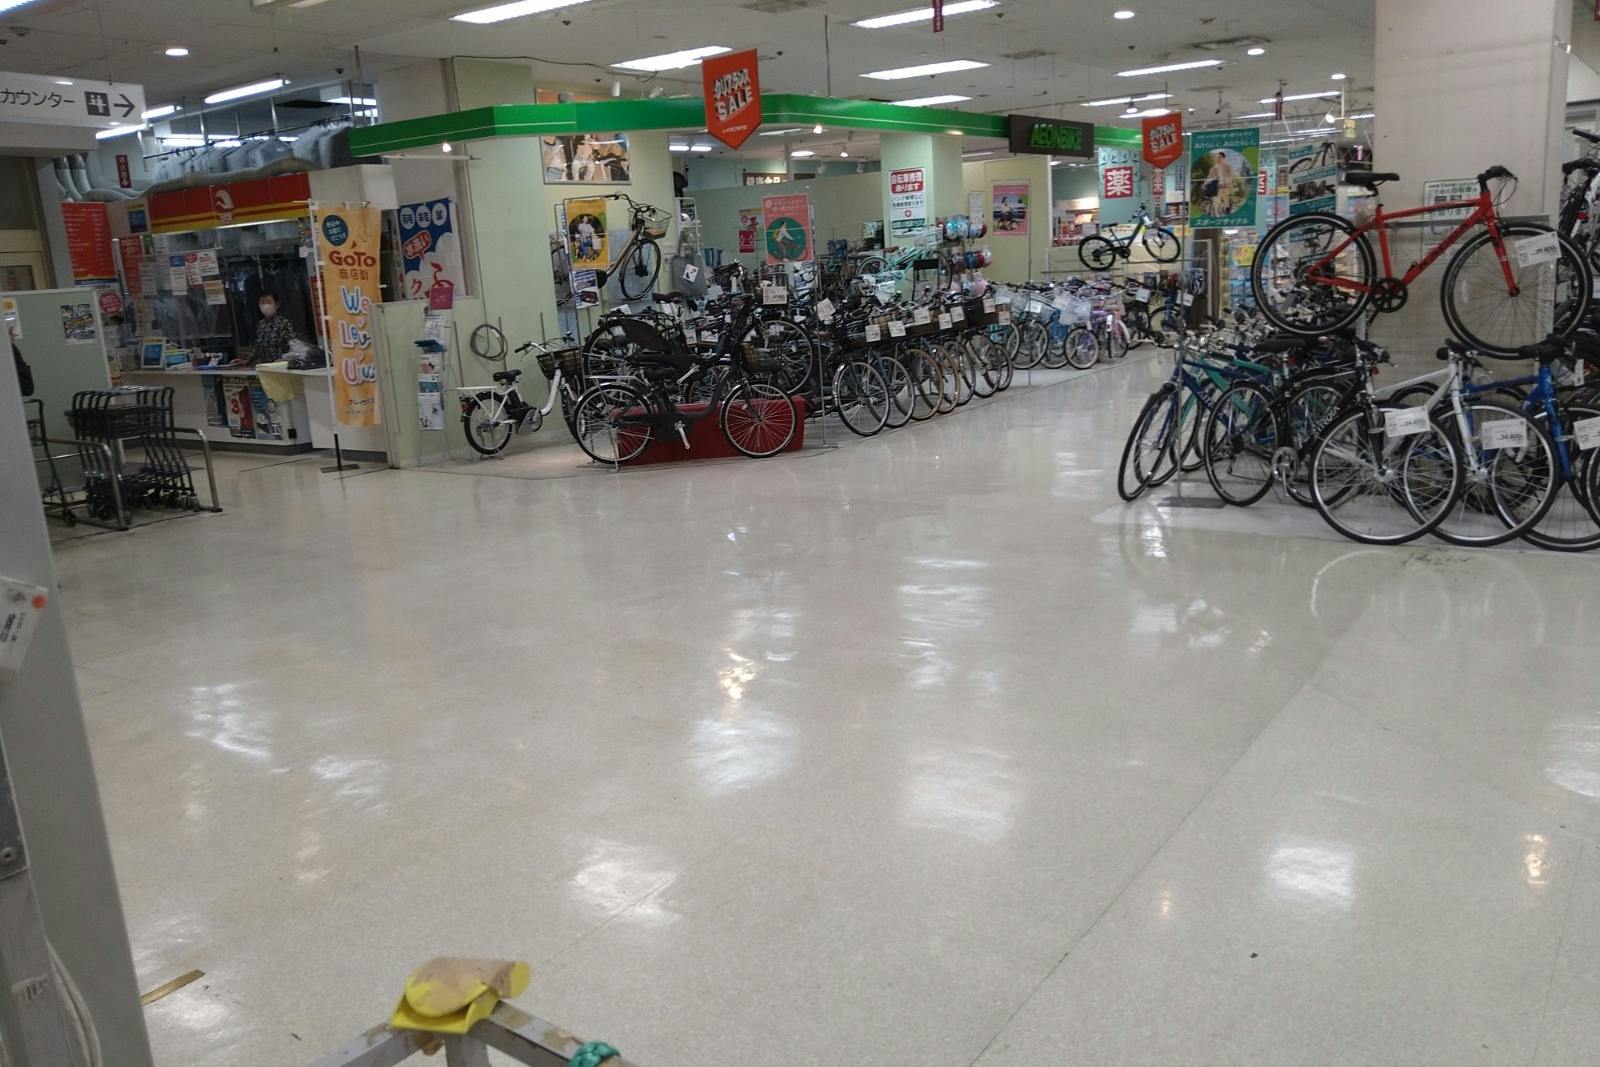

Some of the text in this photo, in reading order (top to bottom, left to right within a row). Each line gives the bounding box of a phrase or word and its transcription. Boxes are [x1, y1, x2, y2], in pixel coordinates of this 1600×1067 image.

[716, 87, 753, 121] SALE
[1150, 133, 1177, 153] SALE
[1106, 169, 1131, 196] 薬
